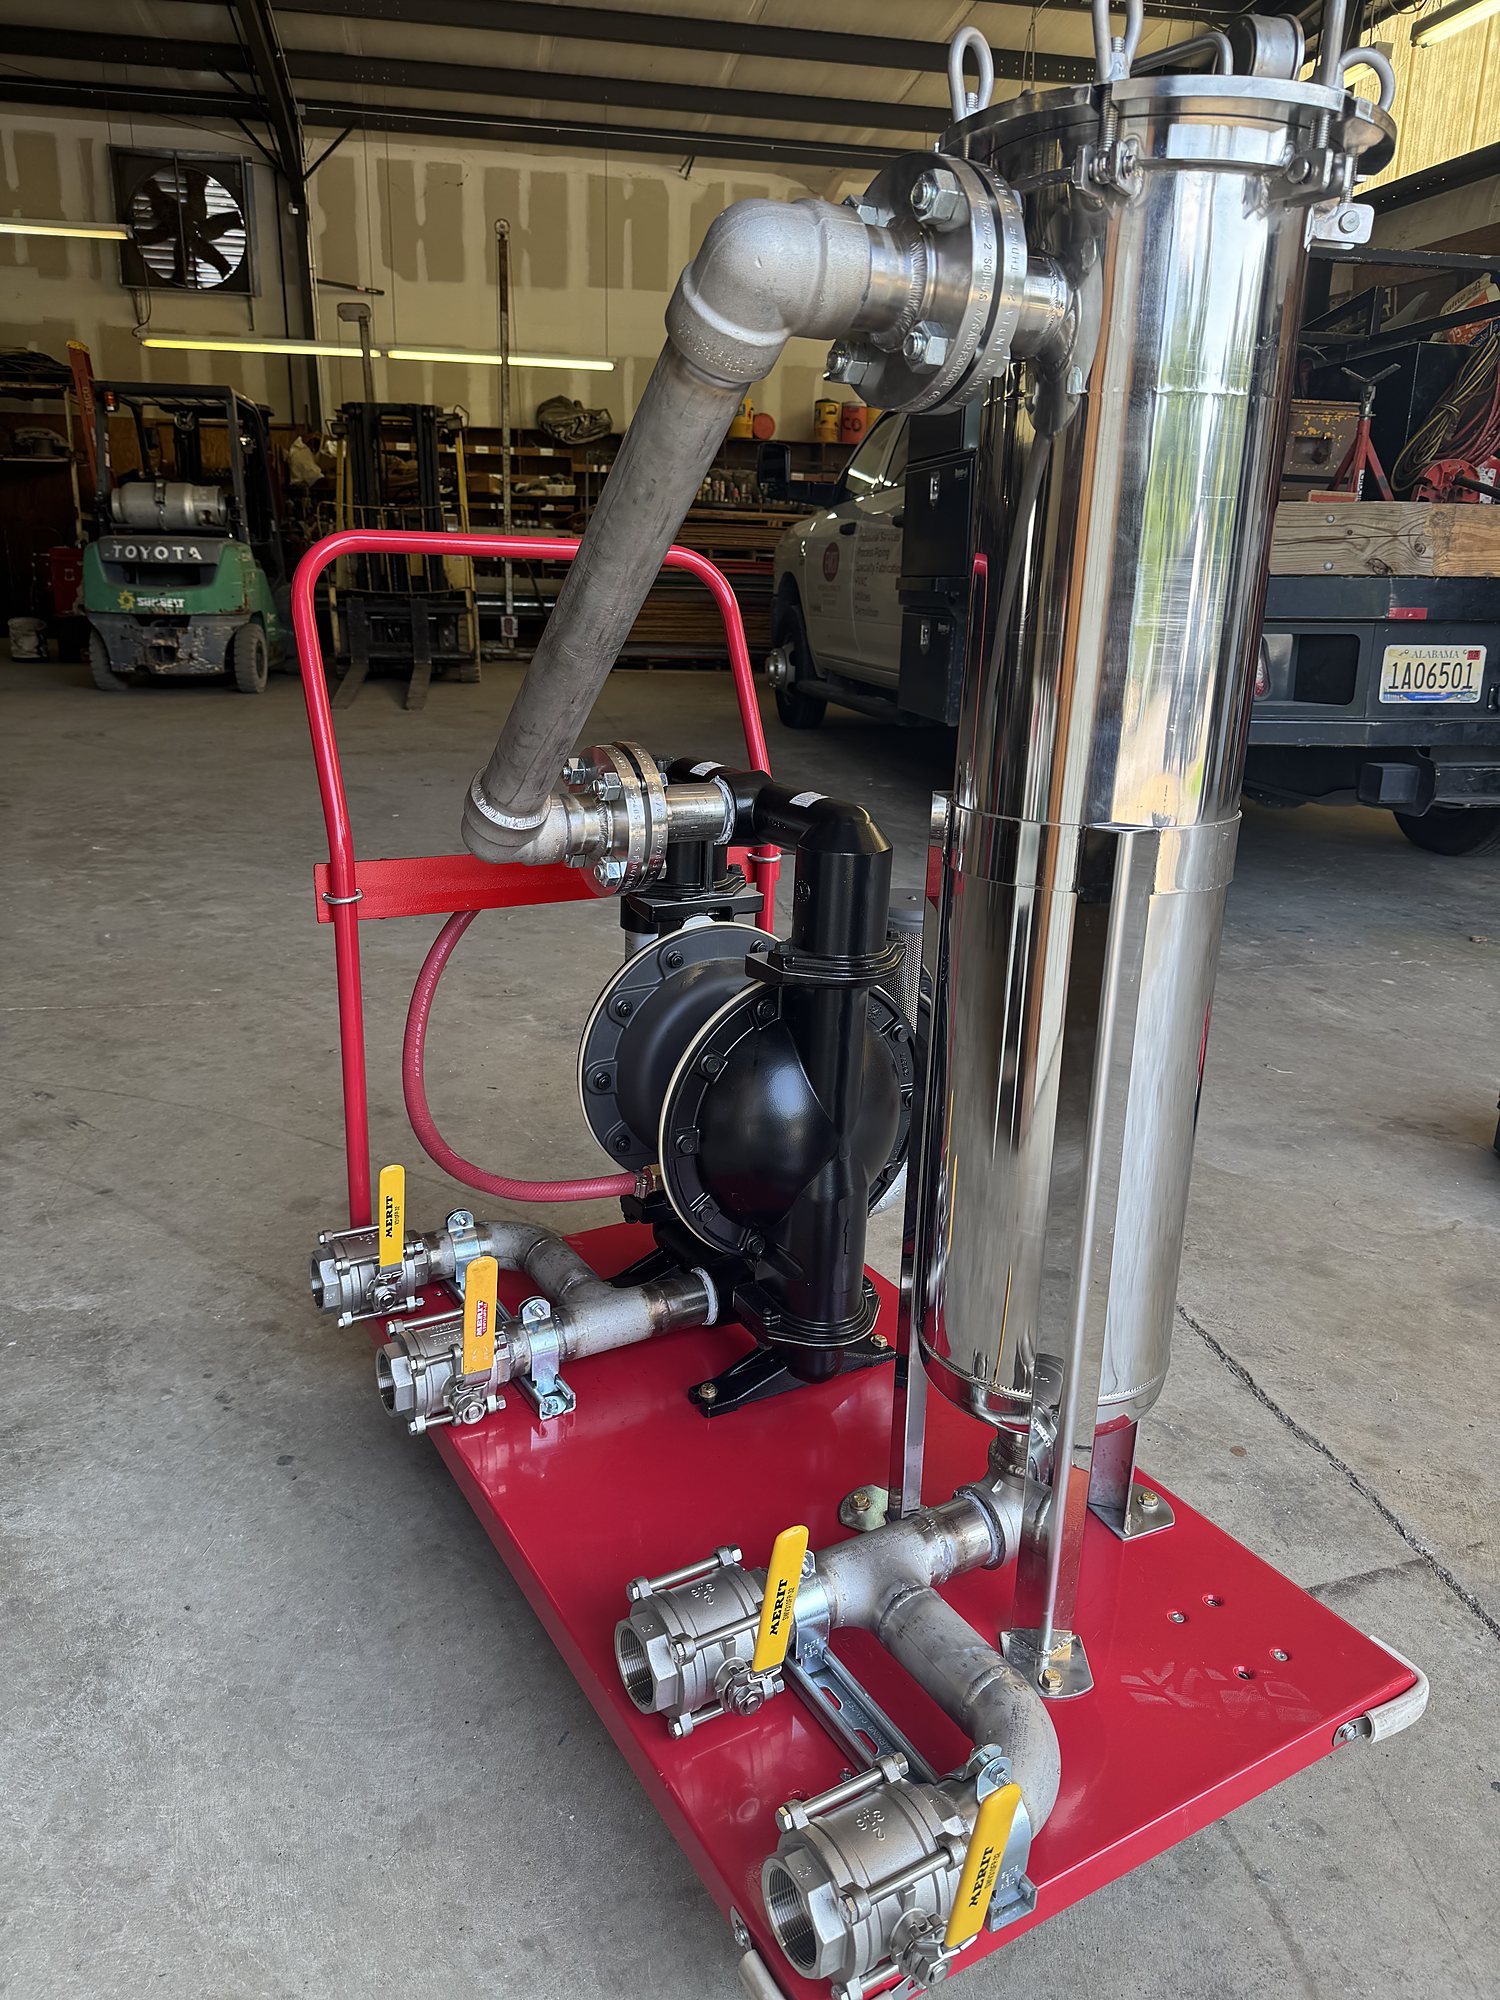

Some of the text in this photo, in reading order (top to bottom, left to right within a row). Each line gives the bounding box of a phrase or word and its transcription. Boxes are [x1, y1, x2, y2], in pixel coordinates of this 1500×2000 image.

[112, 545, 203, 561] TOYOTA
[1411, 650, 1460, 659] ALABAMA
[1388, 662, 1473, 690] 1A06501
[385, 1195, 393, 1238] MERIT
[476, 1300, 484, 1337] MERIT
[769, 1578, 788, 1635] MERIT
[969, 1846, 994, 1908] MERIT
